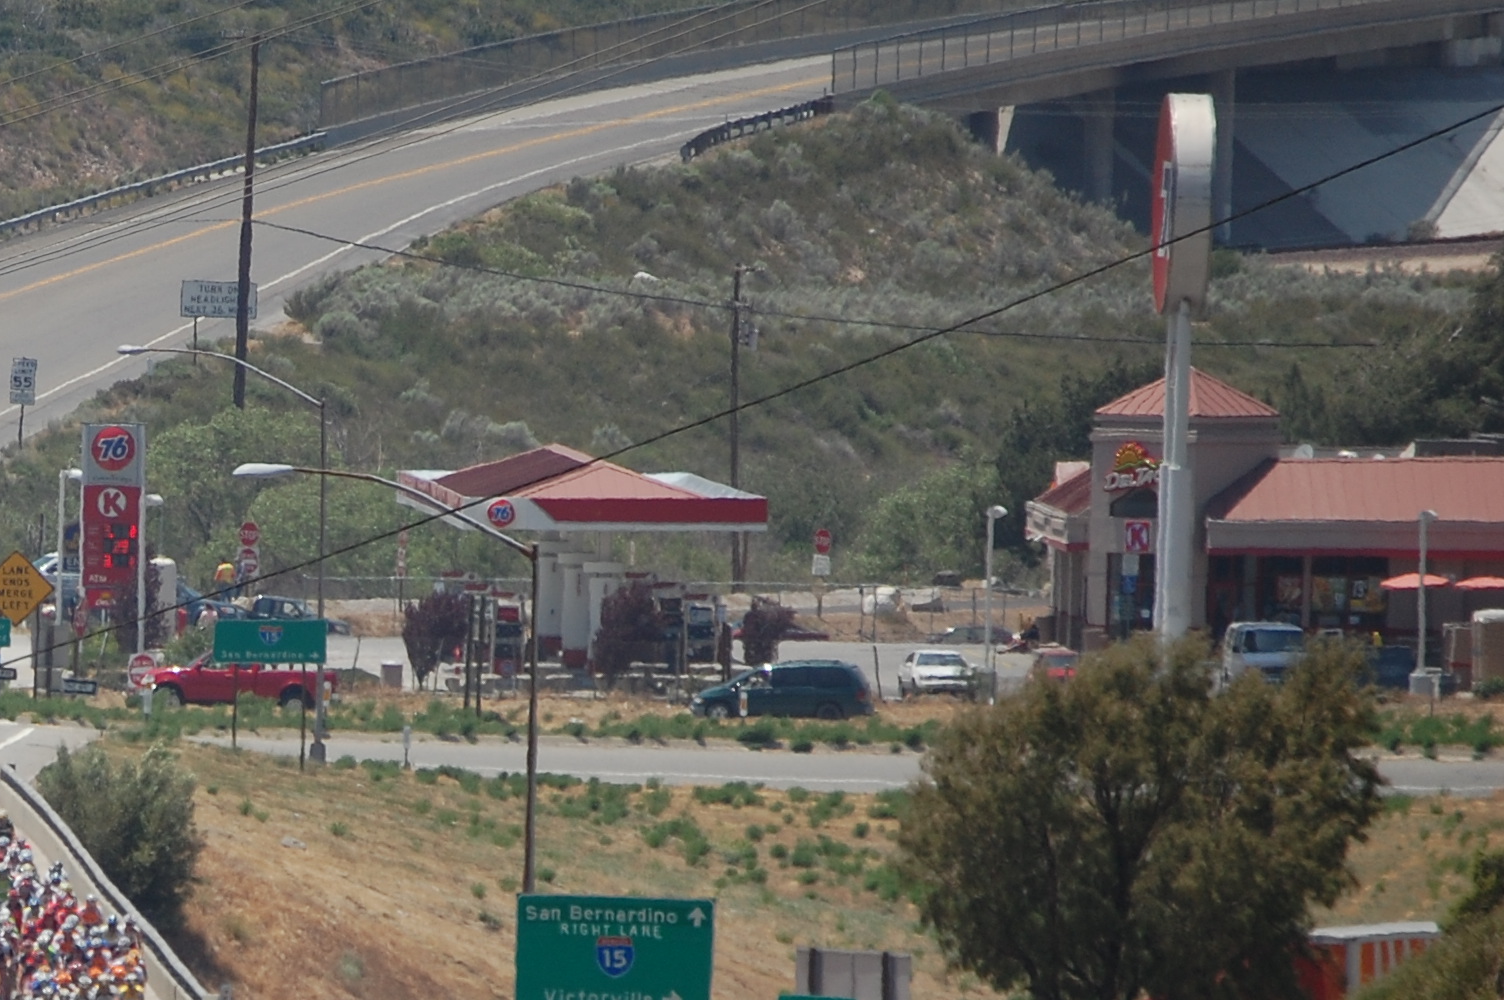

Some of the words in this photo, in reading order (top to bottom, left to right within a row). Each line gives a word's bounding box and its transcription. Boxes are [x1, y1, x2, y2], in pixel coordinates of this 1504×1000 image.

[13, 375, 32, 388] 55
[98, 435, 128, 461] 76
[492, 505, 510, 521] 76
[2, 566, 29, 575] LANE
[2, 578, 30, 587] ENDS
[2, 601, 29, 610] LEFT
[221, 650, 241, 659] San
[245, 650, 304, 660] Bernardino
[525, 905, 561, 921] San
[569, 905, 679, 924] Bernardino
[559, 923, 611, 937] RIGHT
[619, 924, 663, 939] LANE
[602, 949, 628, 968] 15
